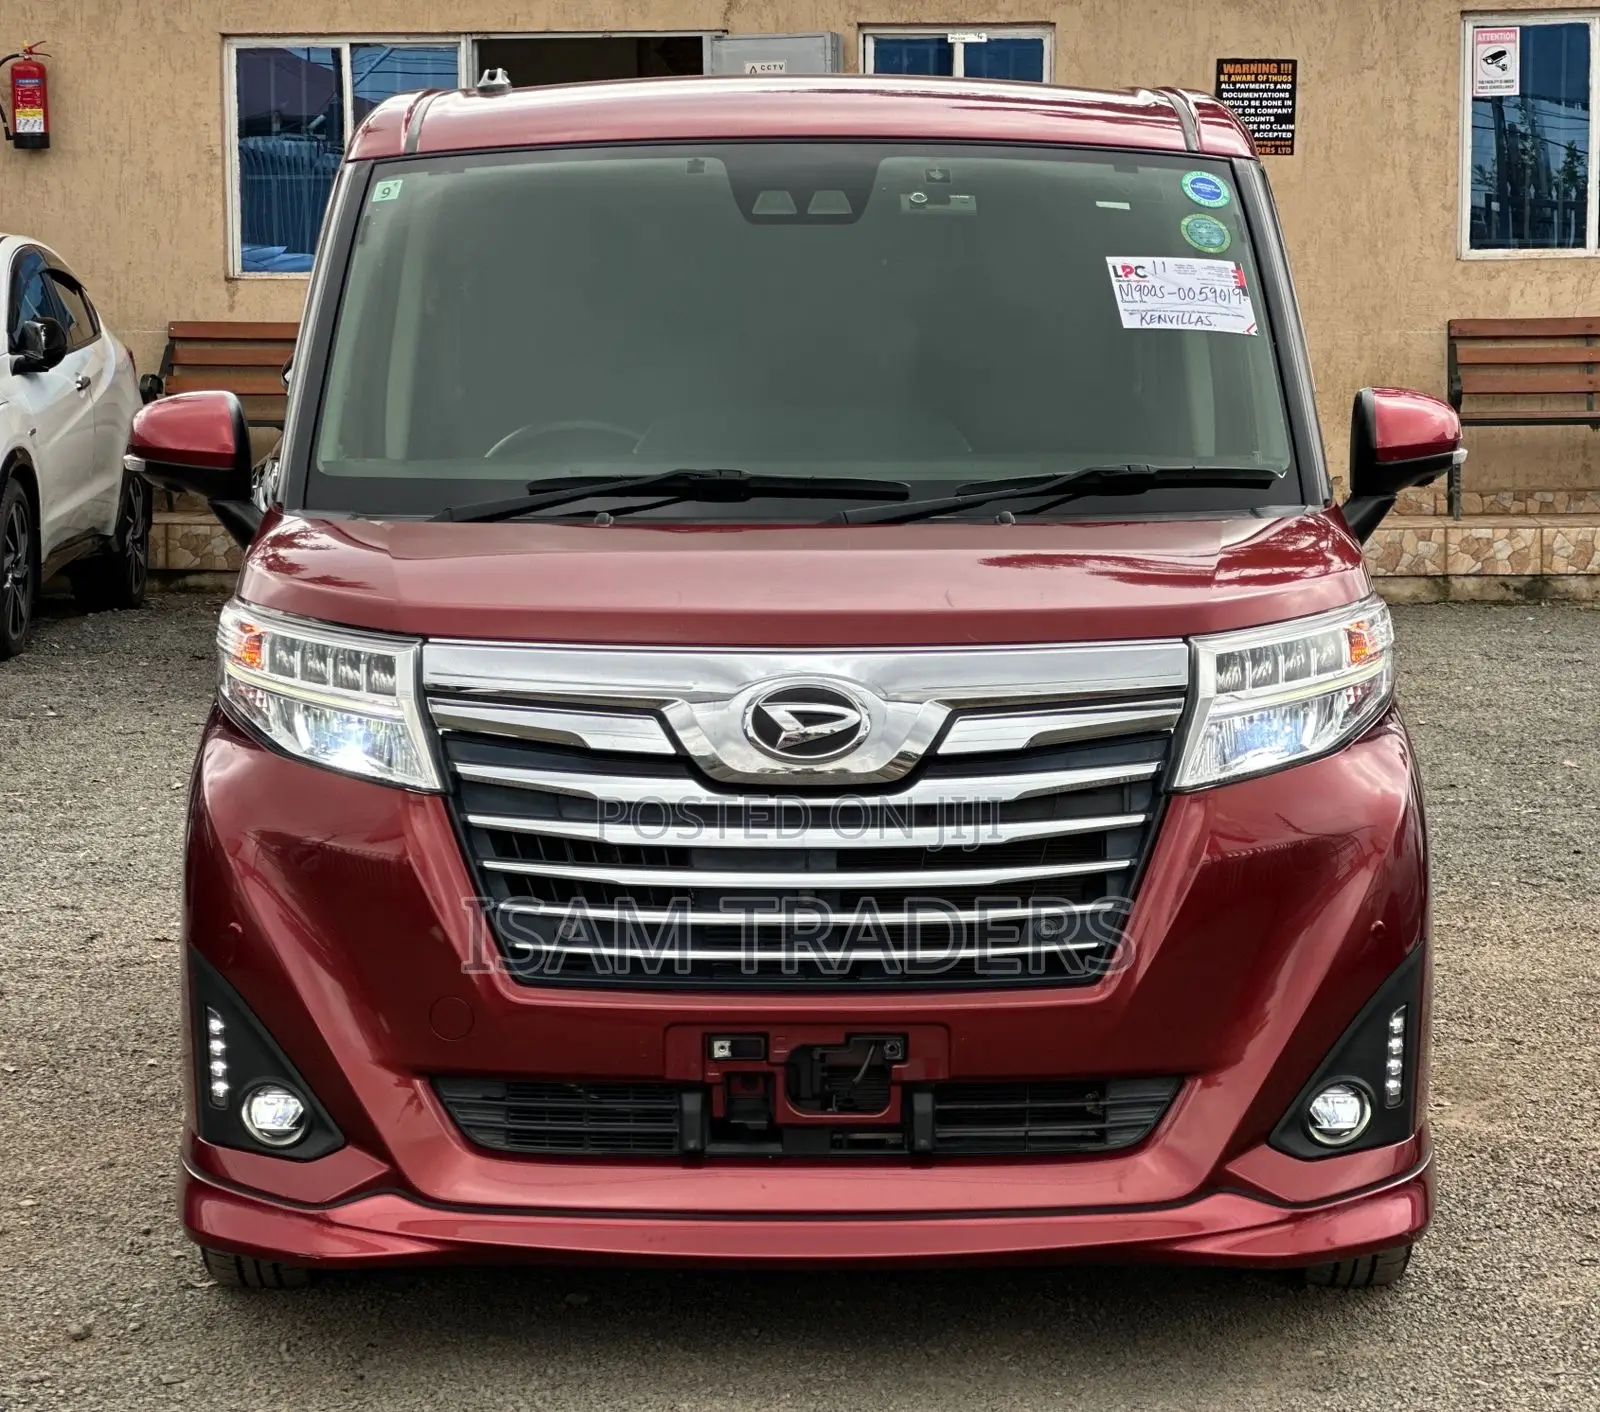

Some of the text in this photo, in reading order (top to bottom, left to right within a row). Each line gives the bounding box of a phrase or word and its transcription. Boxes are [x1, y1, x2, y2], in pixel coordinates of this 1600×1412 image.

[1477, 32, 1515, 41] ATTENTION
[1223, 64, 1292, 73] WARNING !!!
[380, 186, 391, 199] 9
[1112, 264, 1148, 278] LPC
